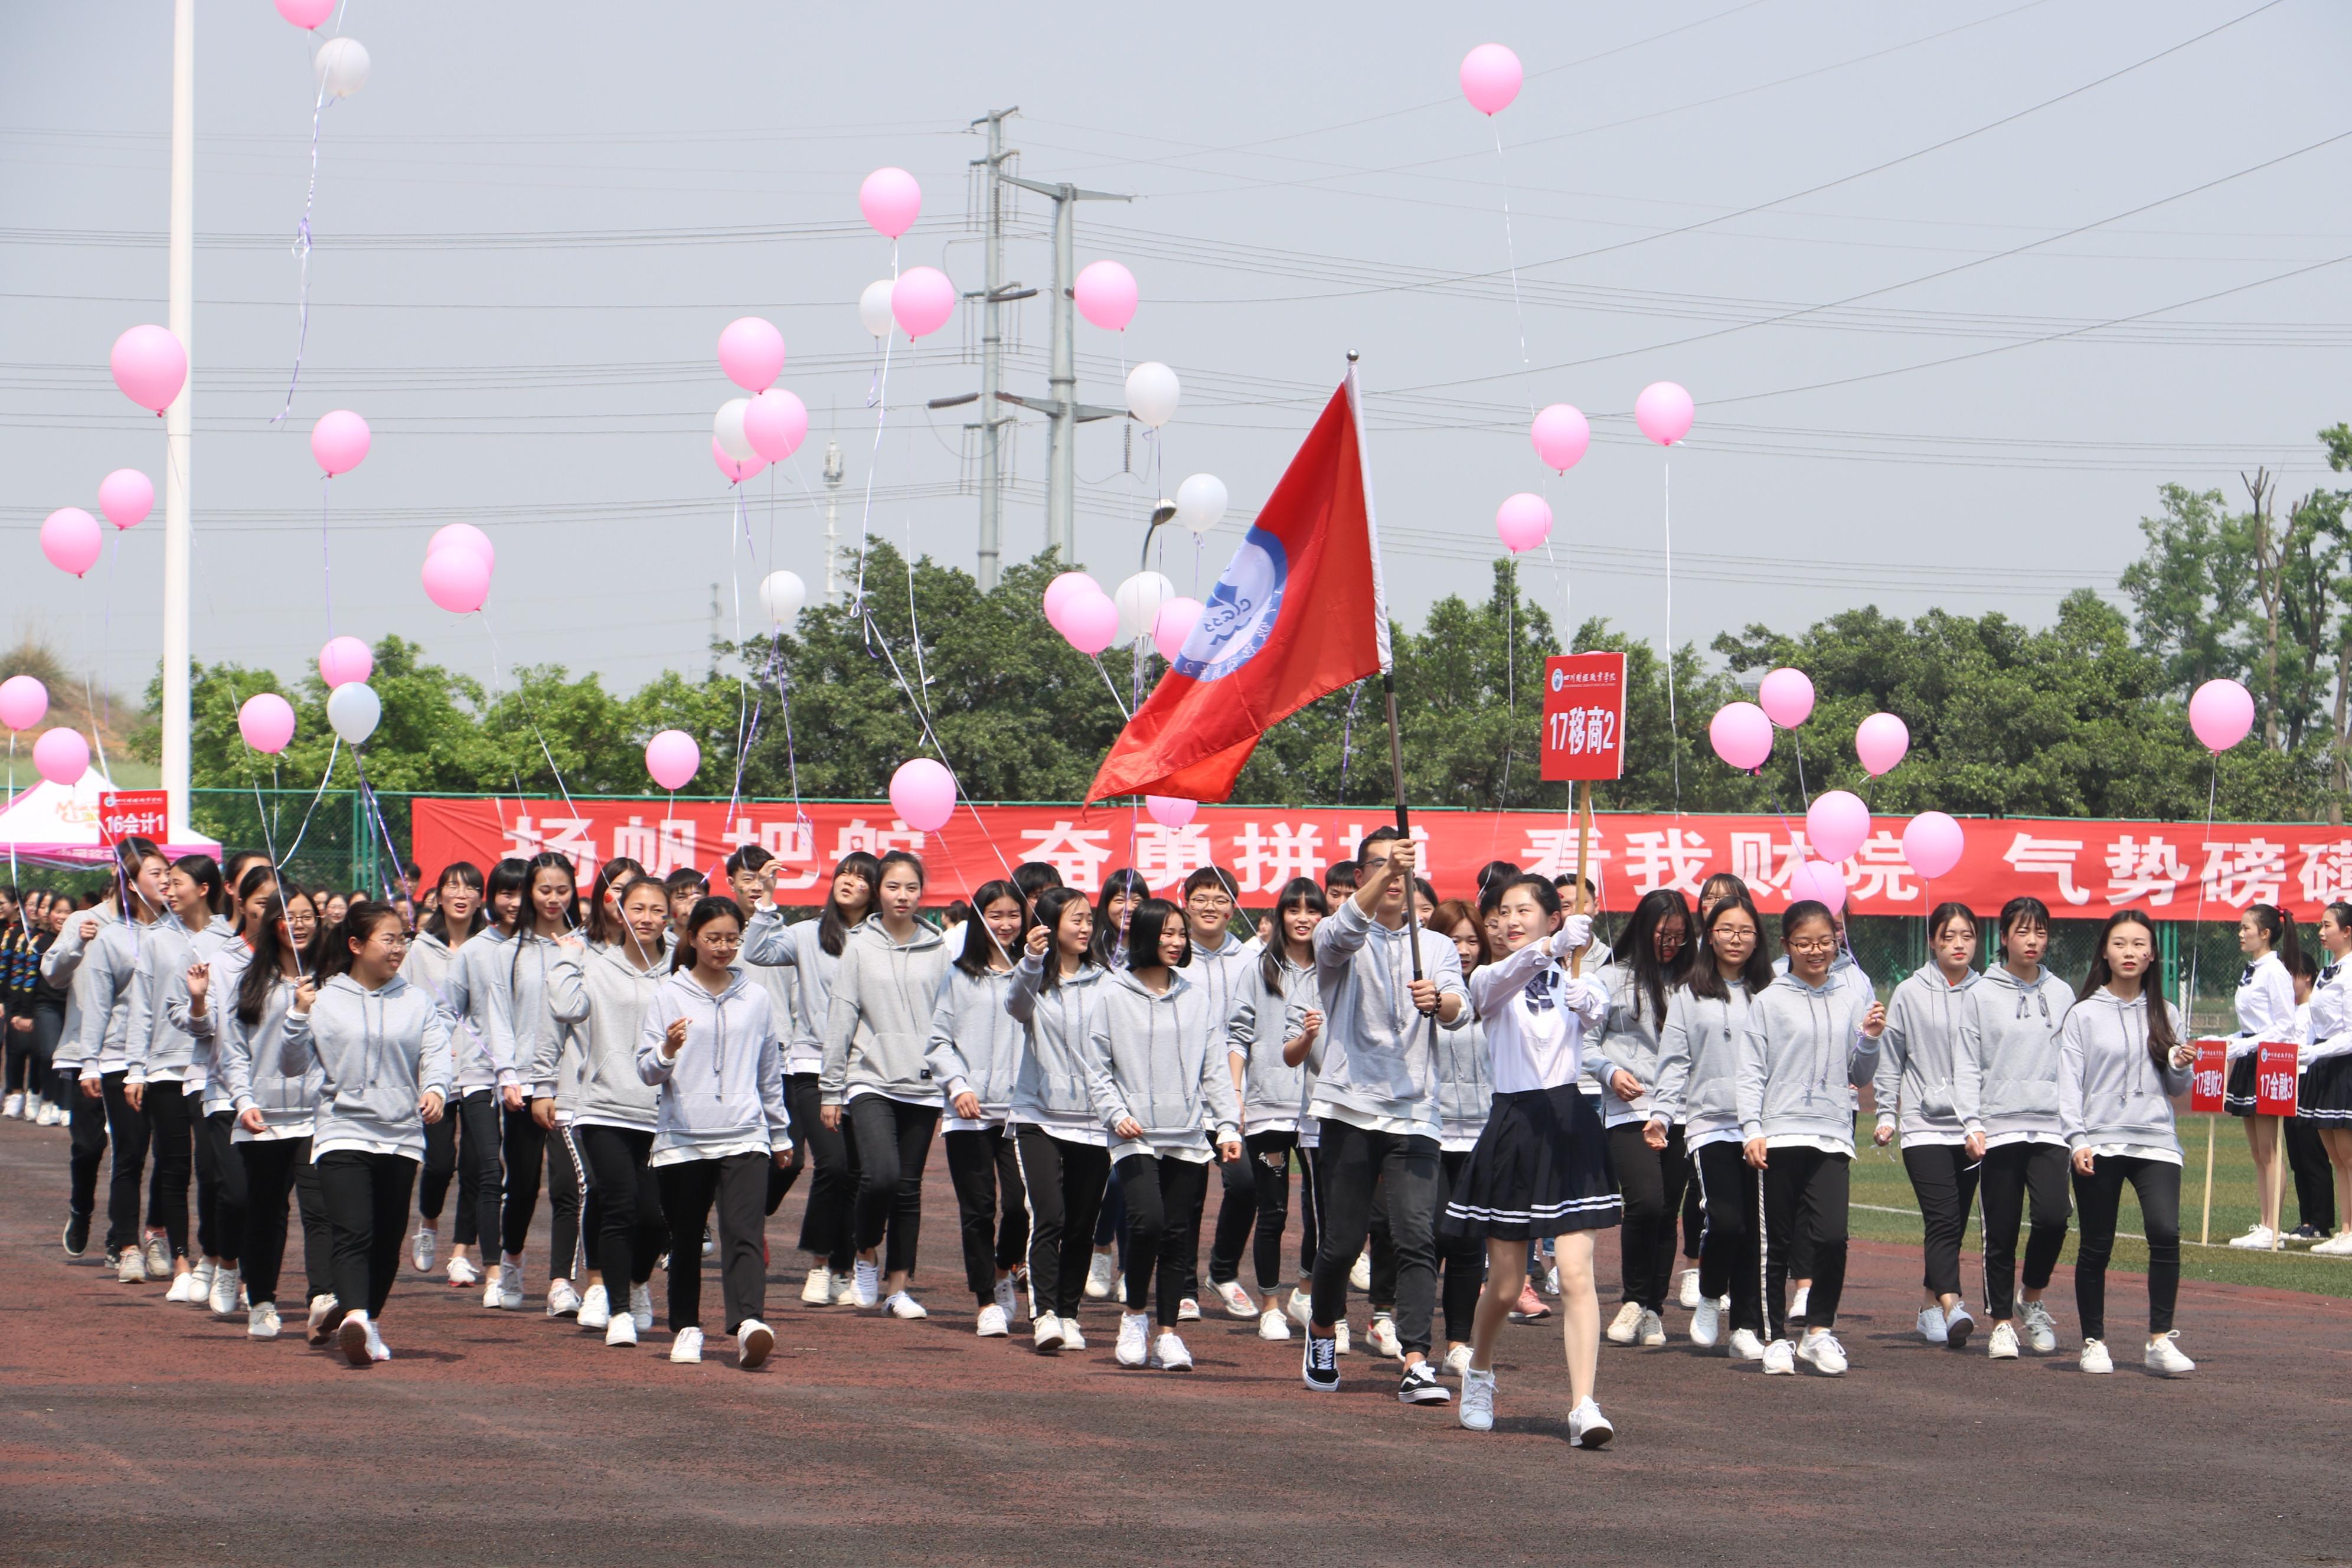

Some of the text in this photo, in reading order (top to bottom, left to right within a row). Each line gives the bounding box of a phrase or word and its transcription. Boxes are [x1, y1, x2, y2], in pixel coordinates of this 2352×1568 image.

[1550, 705, 1615, 755] 17移商2
[105, 811, 165, 835] 16会计1
[1521, 828, 1920, 901] 看我财院
[2196, 1069, 2223, 1098] 17理财2
[2260, 1071, 2294, 1101] 17金融3
